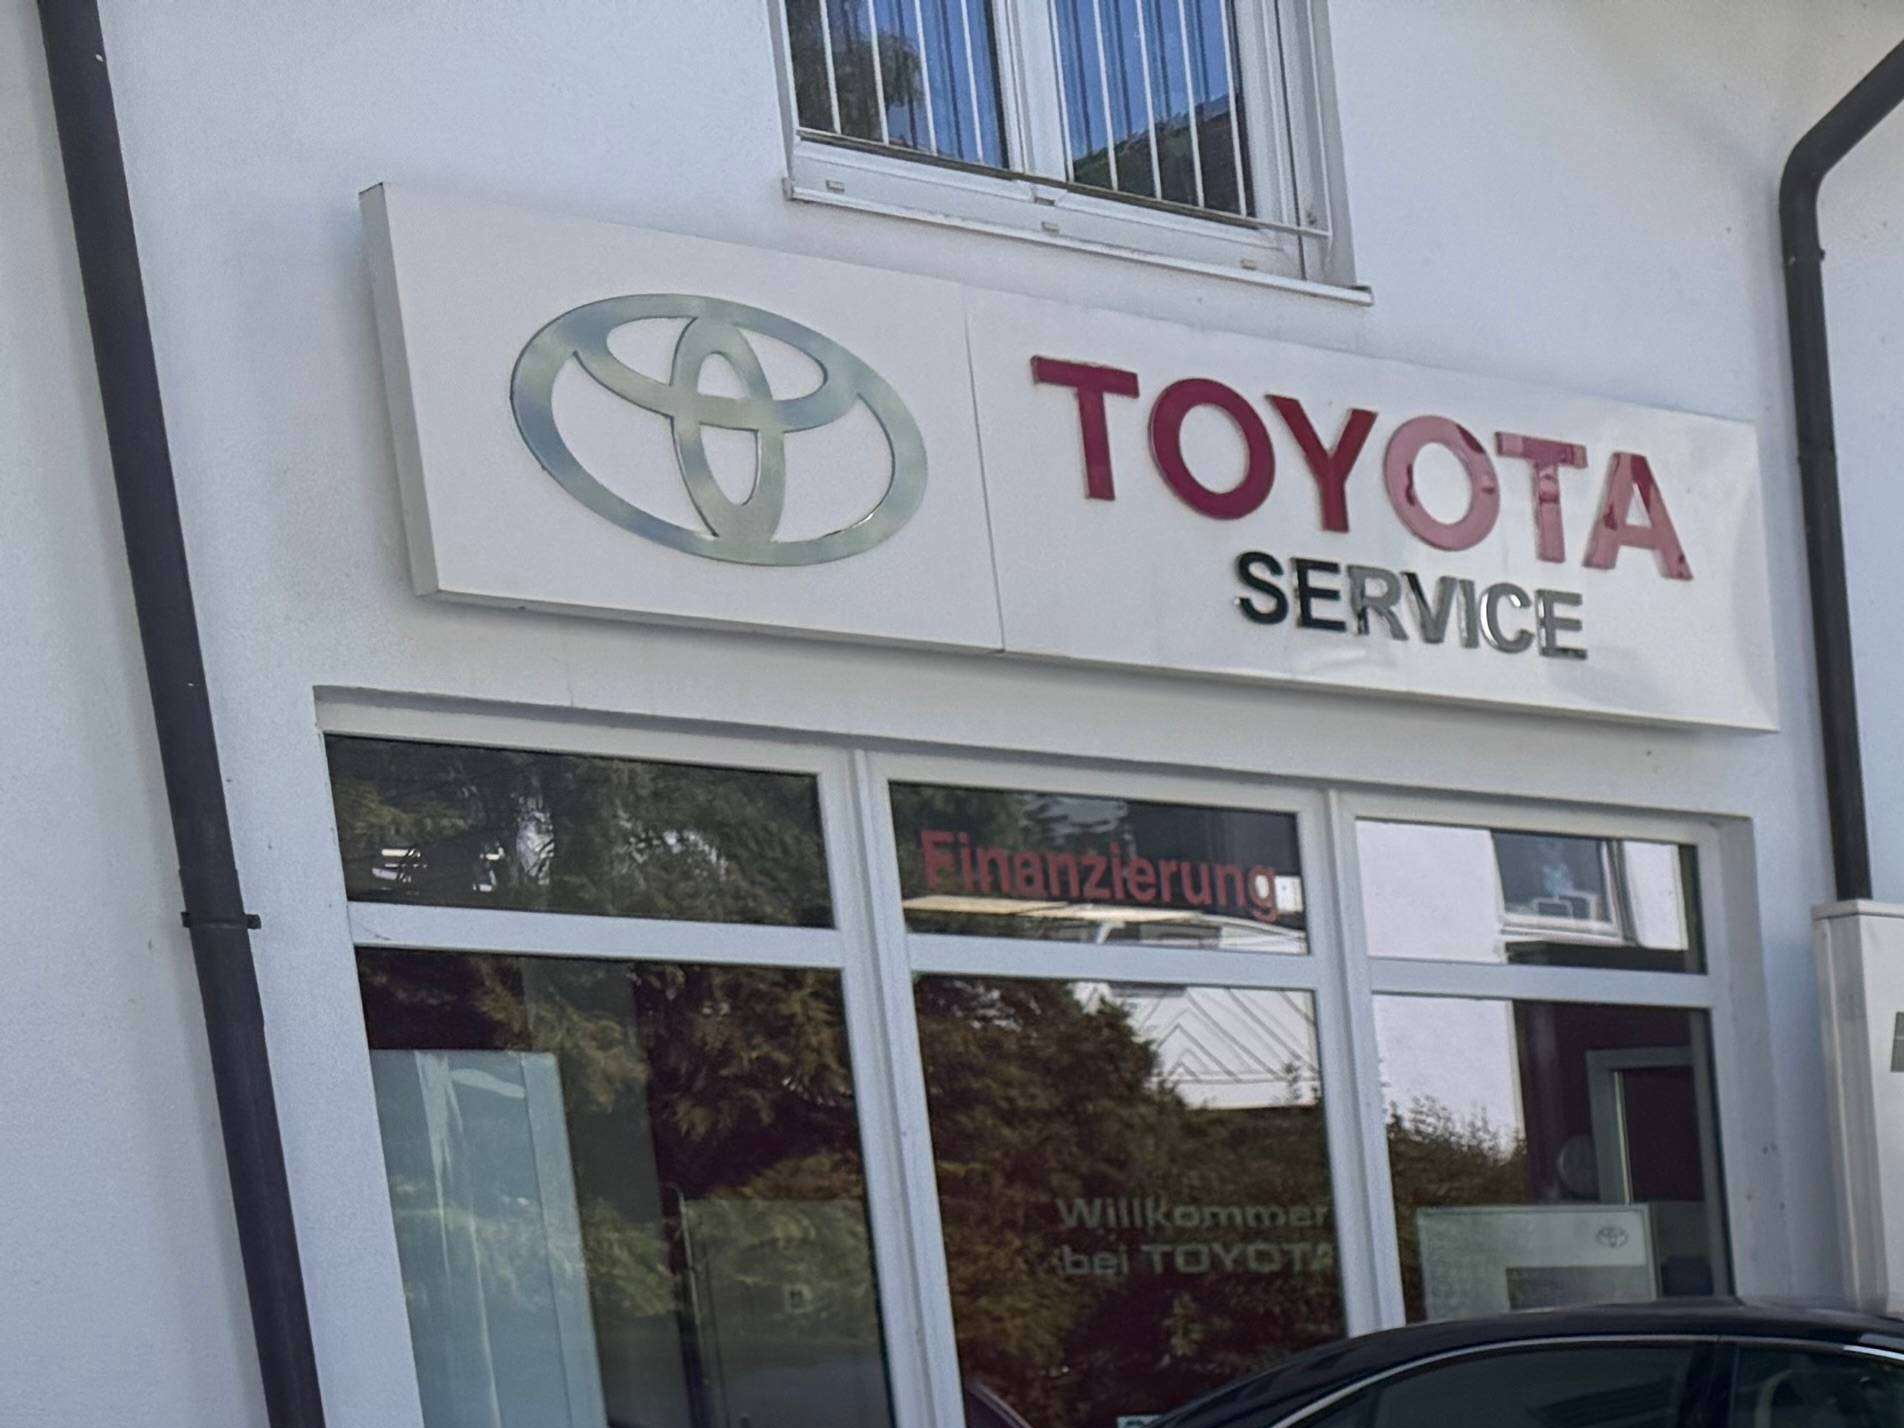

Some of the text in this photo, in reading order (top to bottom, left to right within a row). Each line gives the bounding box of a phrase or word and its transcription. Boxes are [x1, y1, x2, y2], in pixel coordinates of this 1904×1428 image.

[1030, 355, 1693, 580] TOYOTA
[1235, 550, 1588, 660] SERVICE
[920, 829, 1279, 922] Finanzierung
[1062, 1243, 1129, 1276] bei
